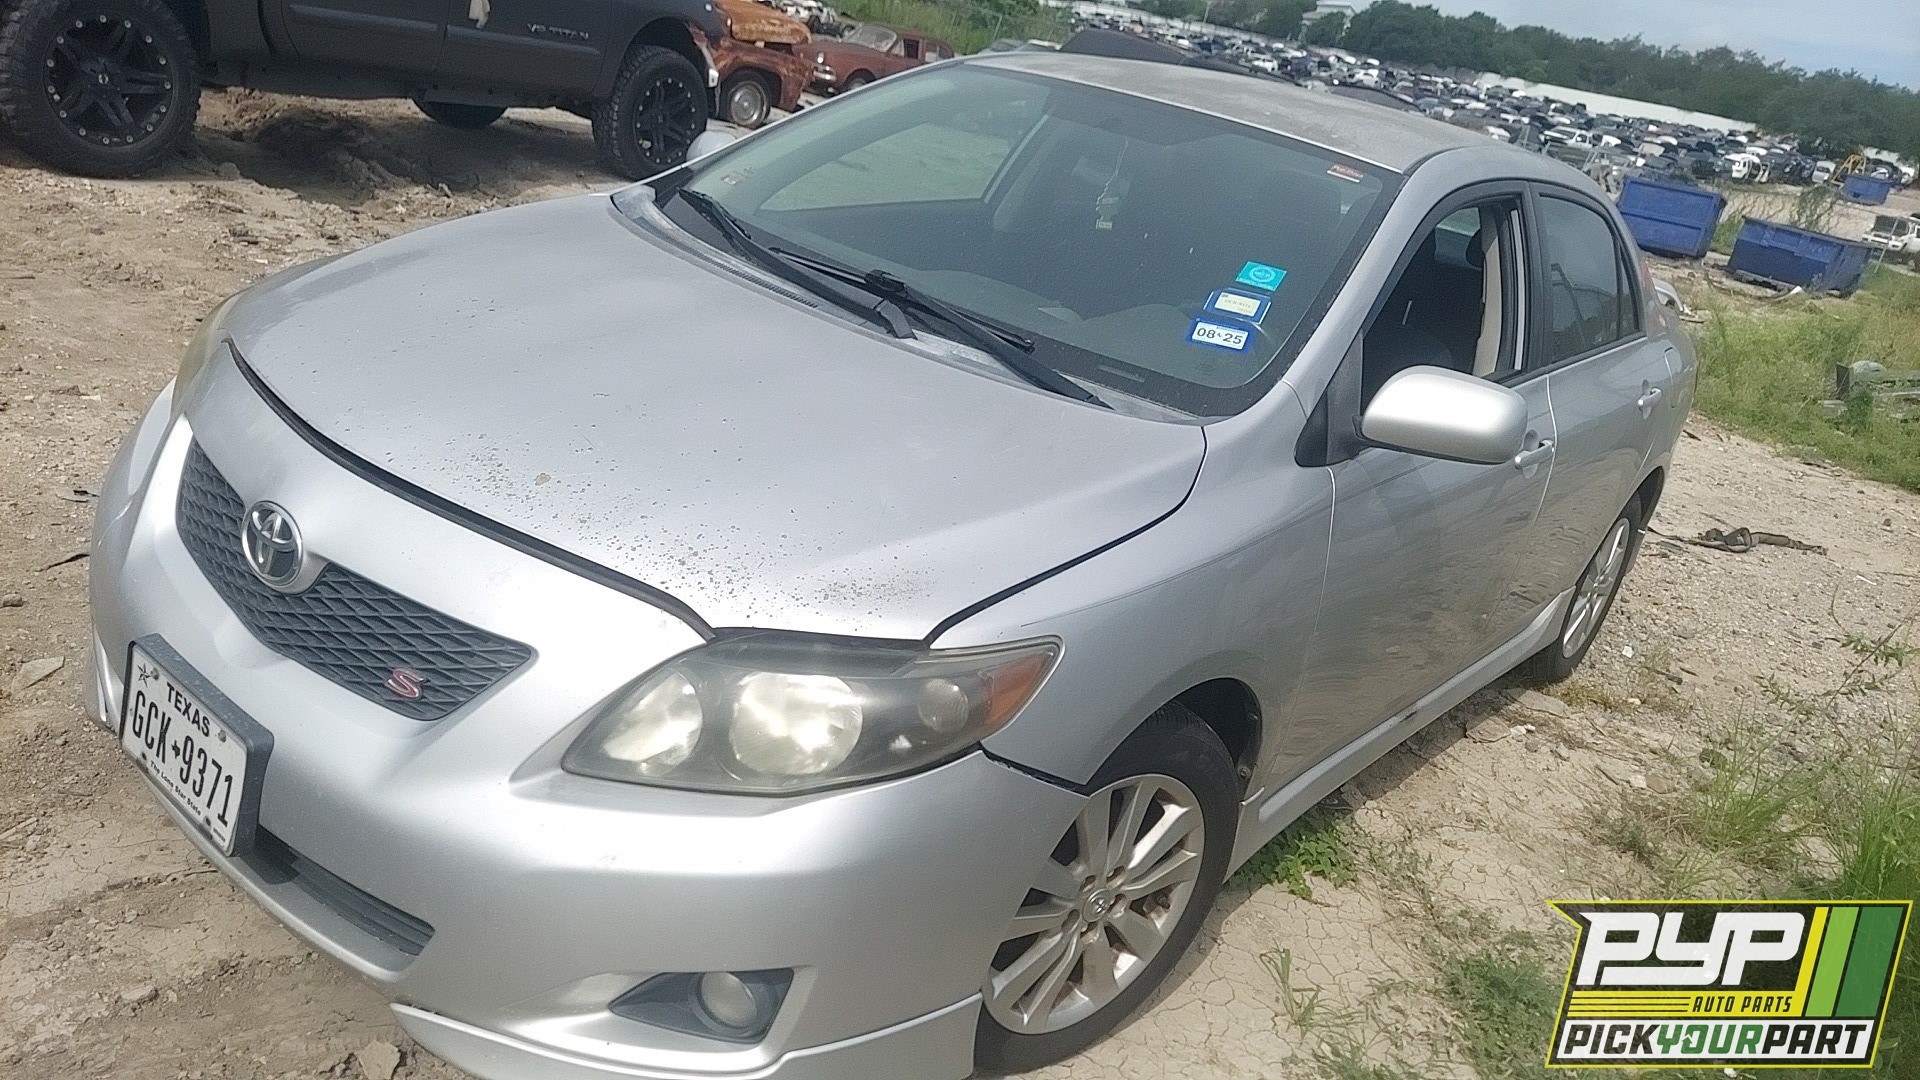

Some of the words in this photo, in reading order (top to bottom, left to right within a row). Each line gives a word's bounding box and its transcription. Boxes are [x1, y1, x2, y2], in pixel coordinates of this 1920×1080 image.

[1197, 327, 1216, 339] 08
[1222, 332, 1243, 345] 25
[385, 668, 423, 698] S
[167, 681, 211, 737] TEXAS
